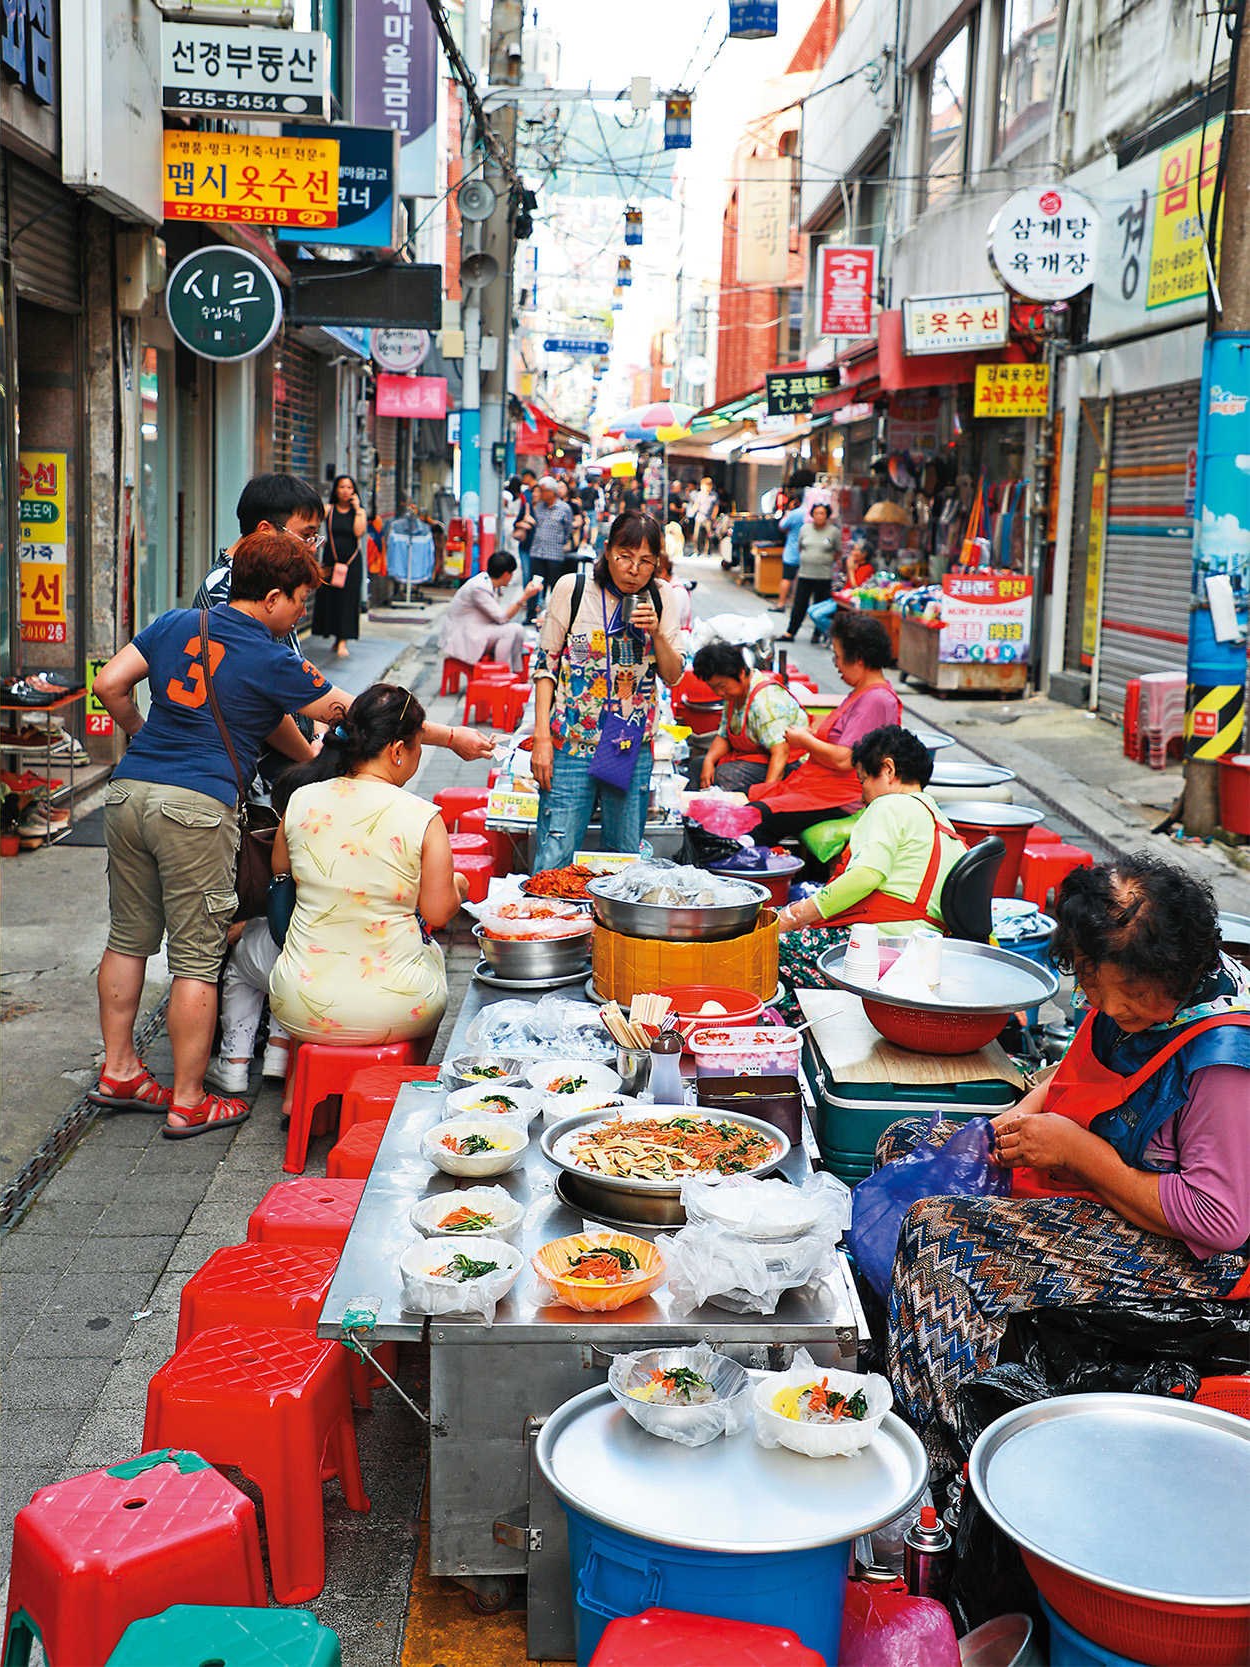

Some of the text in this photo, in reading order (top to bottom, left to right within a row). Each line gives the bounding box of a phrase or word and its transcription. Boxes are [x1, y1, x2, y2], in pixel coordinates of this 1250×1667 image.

[172, 40, 317, 83] 선경부동산
[178, 90, 278, 110] 255-5454
[167, 162, 329, 204] 맵시 옷수선
[191, 205, 288, 222] 245-3518
[1009, 217, 1091, 240] 삼계탕
[1117, 188, 1148, 300] 경
[1009, 252, 1090, 275] 육개장
[182, 268, 261, 305] 시크
[201, 305, 242, 323] 수입의류
[930, 309, 998, 334] 옷수선
[770, 375, 833, 397] 굿프렌드
[22, 544, 54, 561] 가죽
[48, 623, 64, 642] 2층
[166, 635, 226, 709] 3
[302, 659, 326, 688] 3
[91, 715, 112, 731] 2F
